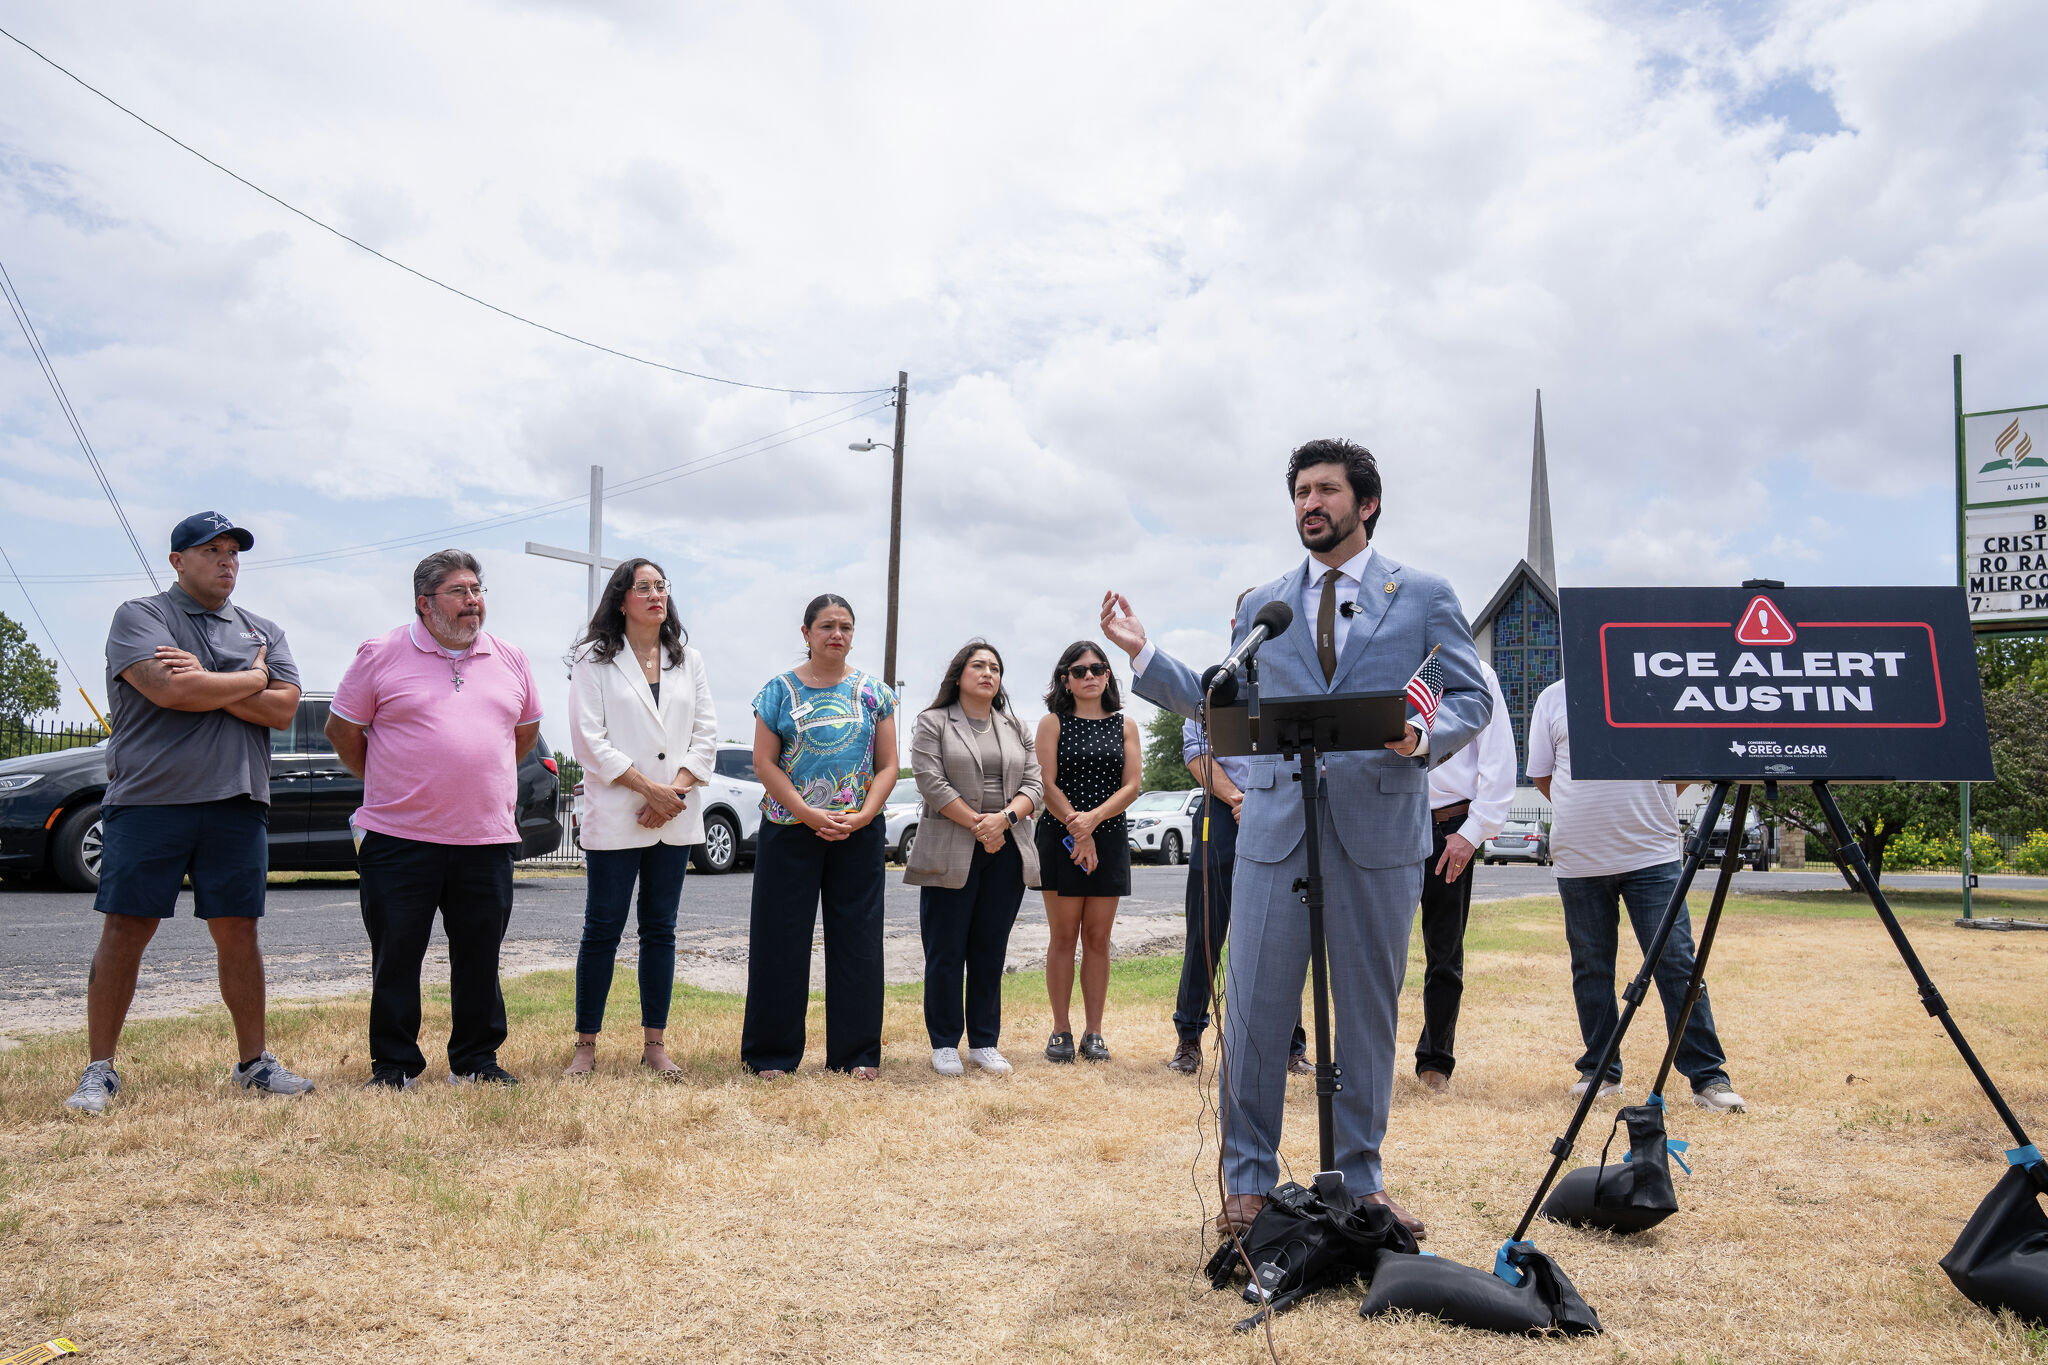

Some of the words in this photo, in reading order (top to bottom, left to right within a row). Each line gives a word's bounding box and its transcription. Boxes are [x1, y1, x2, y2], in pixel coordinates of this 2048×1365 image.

[2007, 482, 2041, 491] AUSTIN
[2034, 514, 2047, 531] B
[1984, 534, 2047, 553] CRIST
[1980, 556, 2008, 573] RO
[2019, 554, 2048, 571] RA
[1970, 575, 2048, 592] MIERCO
[2020, 594, 2048, 610] PM
[1633, 652, 1719, 678] ICE
[1728, 652, 1906, 678] ALERT
[1672, 686, 1873, 712] AUSTIN
[1748, 745, 1782, 754] GREG
[1784, 745, 1827, 754] CASAR
